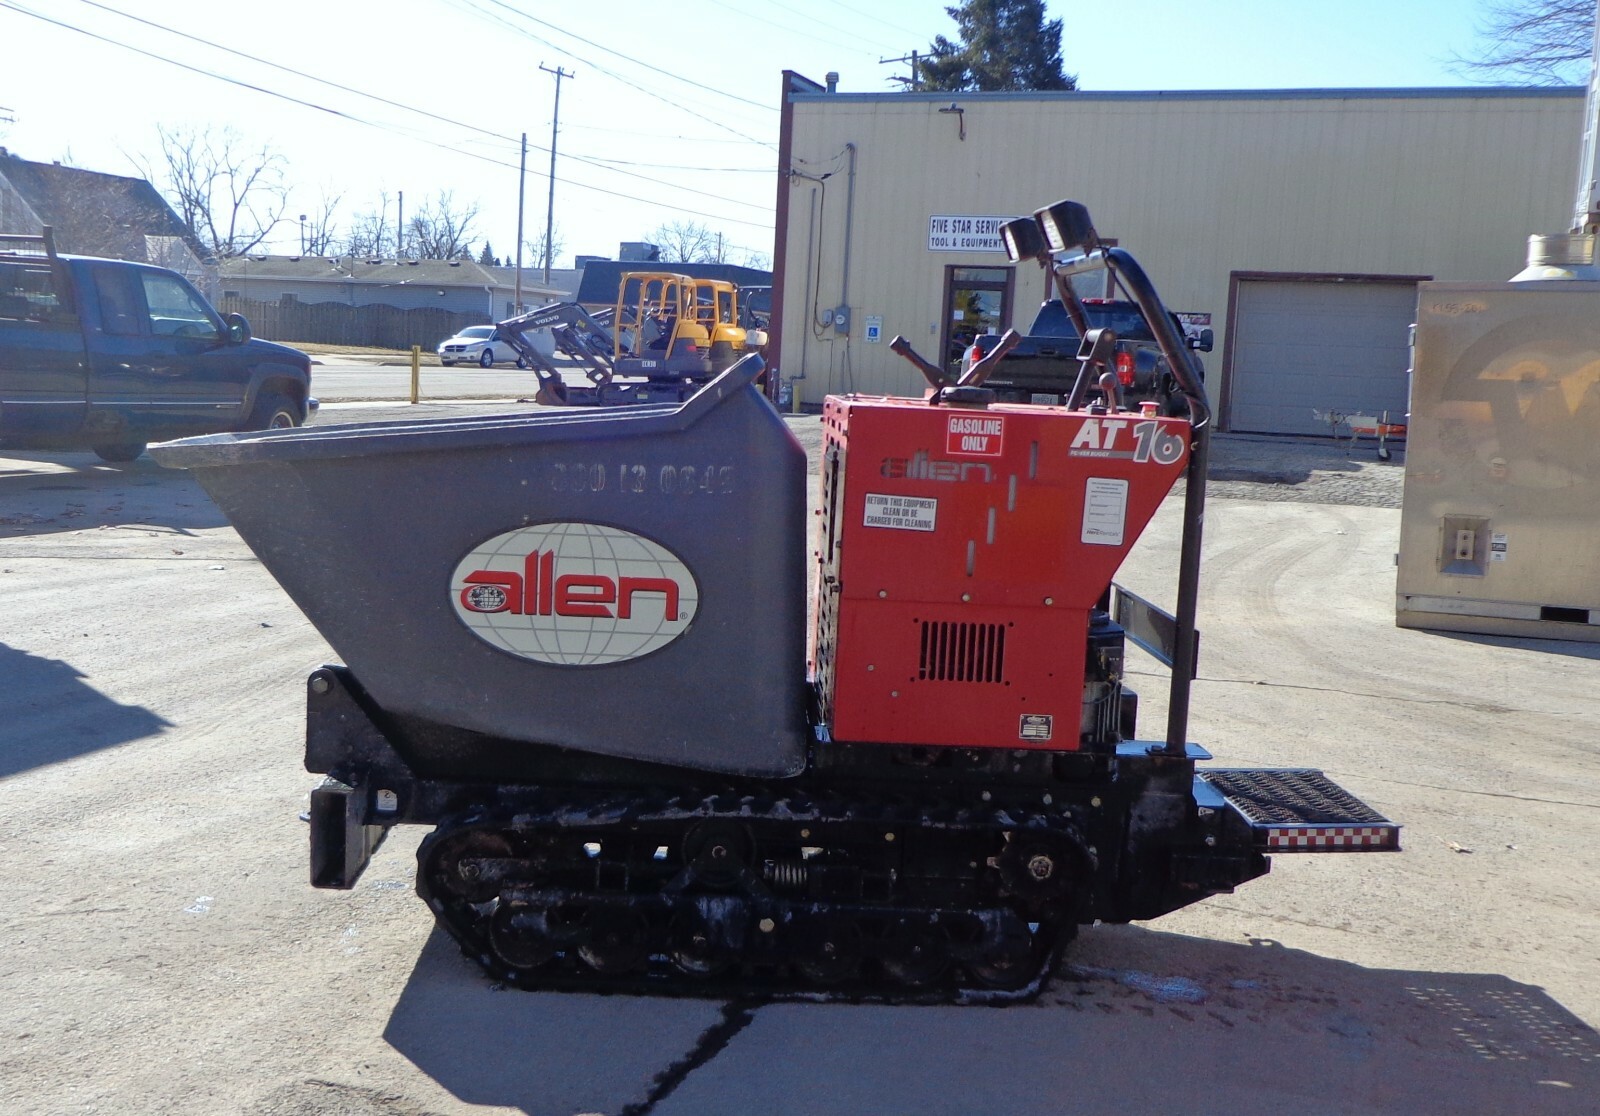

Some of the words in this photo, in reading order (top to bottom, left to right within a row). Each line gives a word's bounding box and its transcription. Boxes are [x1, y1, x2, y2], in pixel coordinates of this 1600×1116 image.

[931, 219, 948, 233] FIVE
[952, 219, 972, 234] STAR
[931, 237, 949, 247] TOOL
[952, 237, 957, 247] &
[961, 238, 1003, 248] EQUIPMENT
[534, 314, 560, 325] VOLVO
[949, 418, 1002, 436] GASOLINE
[961, 436, 989, 452] ONLY
[1069, 418, 1128, 450] AT
[1132, 420, 1185, 465] 16
[867, 496, 888, 505] RETURN
[890, 497, 903, 507] THIS
[904, 499, 935, 509] EQUIPMENT
[882, 507, 900, 516] CLEAN
[902, 508, 909, 517] OR
[910, 509, 918, 518] BE
[866, 516, 891, 525] CHARGED
[893, 518, 903, 527] FOR
[904, 519, 932, 529] CLEANING
[460, 549, 680, 622] allen
